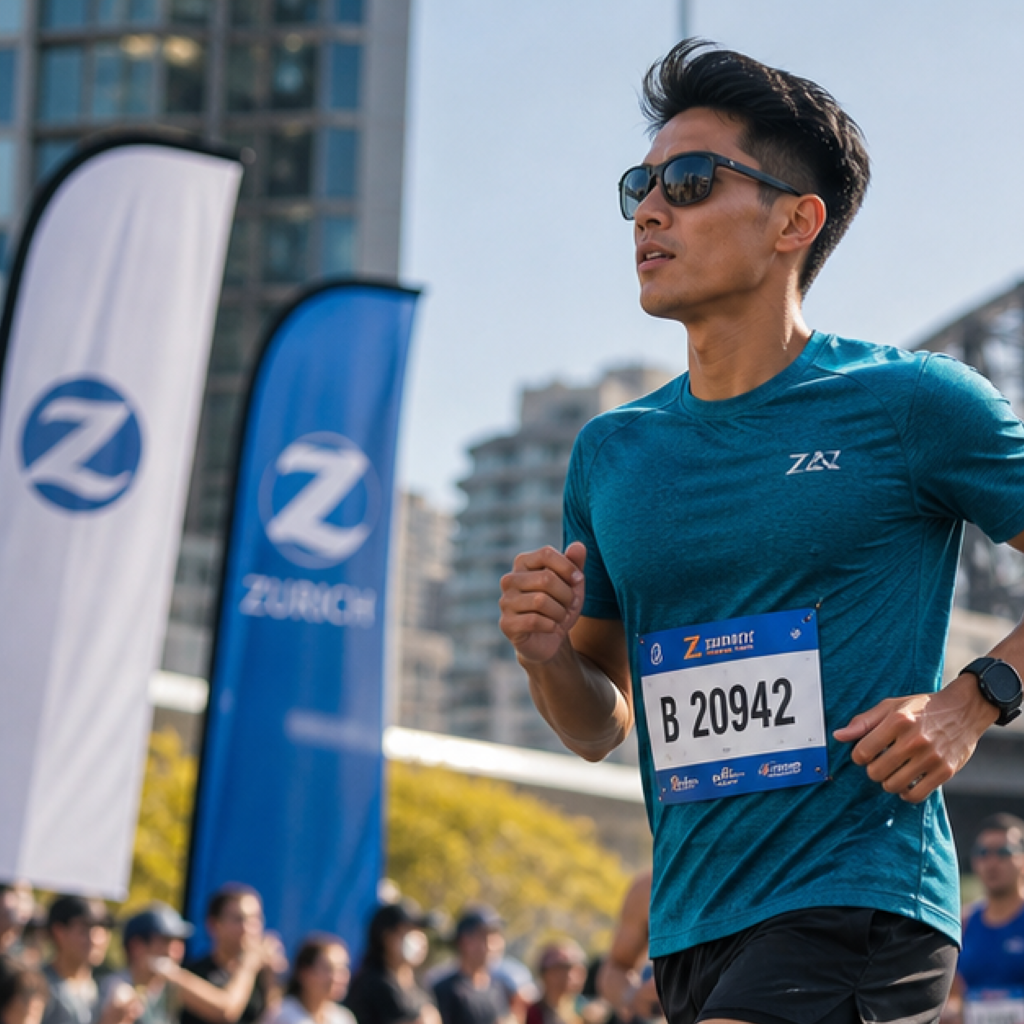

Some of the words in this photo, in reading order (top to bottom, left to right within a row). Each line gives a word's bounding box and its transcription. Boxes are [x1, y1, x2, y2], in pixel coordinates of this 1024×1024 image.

[26, 395, 134, 501] Z
[266, 442, 371, 560] Z
[239, 573, 378, 629] ZURICH
[660, 696, 680, 743] B
[690, 677, 796, 739] 20942
